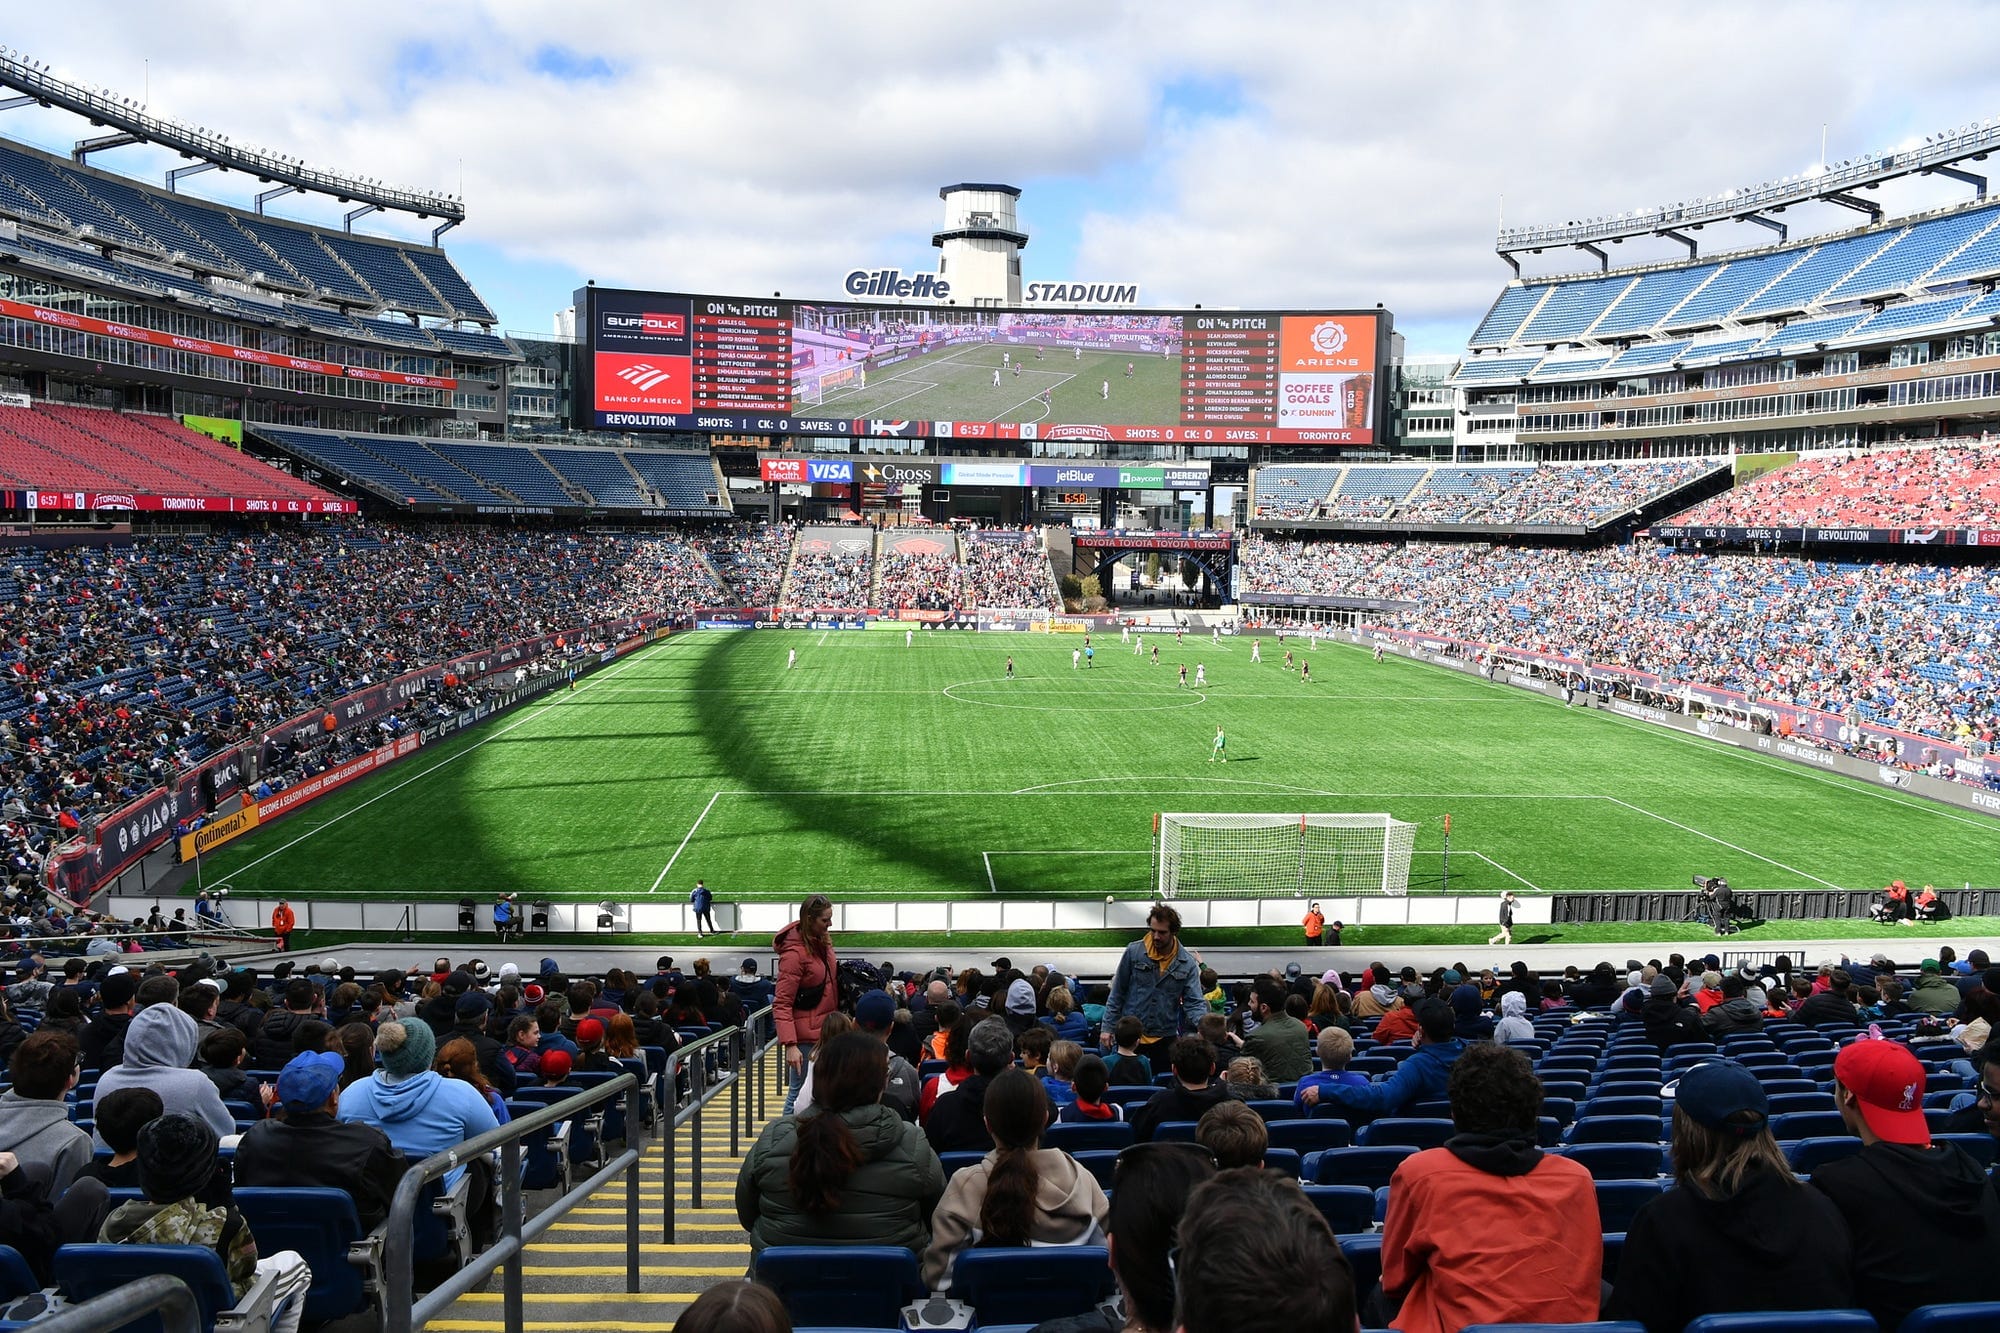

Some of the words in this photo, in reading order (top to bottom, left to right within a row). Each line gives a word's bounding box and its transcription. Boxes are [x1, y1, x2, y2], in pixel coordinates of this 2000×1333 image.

[846, 270, 950, 298] Gillette
[1026, 283, 1136, 302] STADIUM
[708, 303, 724, 314] ON
[728, 304, 740, 315] THE
[743, 304, 777, 317] PITCH
[42, 311, 57, 322] CVS
[58, 312, 80, 326] Health
[608, 317, 678, 329] SUFFOLK
[1197, 319, 1214, 329] ON
[1217, 319, 1230, 329] THE
[1232, 318, 1266, 329] PITCH
[114, 327, 128, 337] CVS
[129, 329, 149, 340] Health
[179, 340, 192, 348] CVS
[240, 352, 251, 360] CVS
[1929, 364, 1944, 374] CVS
[1285, 384, 1334, 393] COFFEE
[1288, 395, 1330, 403] GOALS
[606, 414, 676, 426] REVOLUTION
[698, 417, 733, 428] SHOTS:
[742, 419, 747, 429] 1
[758, 420, 774, 429] CK:
[779, 420, 788, 430] 0
[800, 421, 832, 431] SAVES:
[839, 422, 846, 431] 0
[940, 424, 947, 434] 0
[960, 424, 986, 436] 6:57
[1024, 425, 1032, 437] 0
[1055, 426, 1103, 438] TORONTO
[1126, 429, 1160, 439] SHOTS:
[1165, 429, 1174, 439] 0
[1184, 430, 1199, 439] CK:
[1204, 429, 1212, 439] 0
[1226, 430, 1258, 440] SAVES:
[1266, 431, 1271, 440] 1
[1298, 431, 1340, 440] TORONTO
[1342, 431, 1351, 440] FC
[778, 461, 800, 470] CVS
[809, 464, 850, 479] VISA
[1056, 470, 1093, 483] jetBlue
[29, 495, 35, 507] 0
[41, 495, 57, 505] 6:57
[77, 496, 83, 507] 0
[99, 496, 130, 504] TORONTO
[162, 498, 195, 508] TORONTO
[197, 499, 205, 509] FC
[246, 500, 269, 510] SHOTS:
[272, 502, 277, 510] 0
[288, 502, 298, 511] CK:
[307, 503, 311, 511] 0
[322, 503, 342, 512] SAVES:
[1065, 493, 1085, 503] 6:58
[1661, 528, 1684, 536] SHOTS:
[1720, 529, 1726, 538] 0
[1746, 530, 1771, 538] SAVES:
[1775, 530, 1781, 539] 0
[1818, 530, 1869, 541] REVOLUTION
[1970, 533, 1976, 543] 0
[1615, 701, 1640, 716] EVERYONE
[1797, 748, 1818, 761] AGES
[1818, 753, 1834, 765] 4-14
[323, 774, 340, 786] BECOME
[343, 765, 357, 778] SEASON
[357, 756, 373, 770] MEMBER
[1954, 758, 1983, 776] BRING
[259, 803, 279, 817] BECOME
[284, 792, 302, 807] SEASON
[303, 780, 322, 797] MEMBER
[1972, 792, 2000, 809] EVER
[195, 814, 240, 854] Continental
